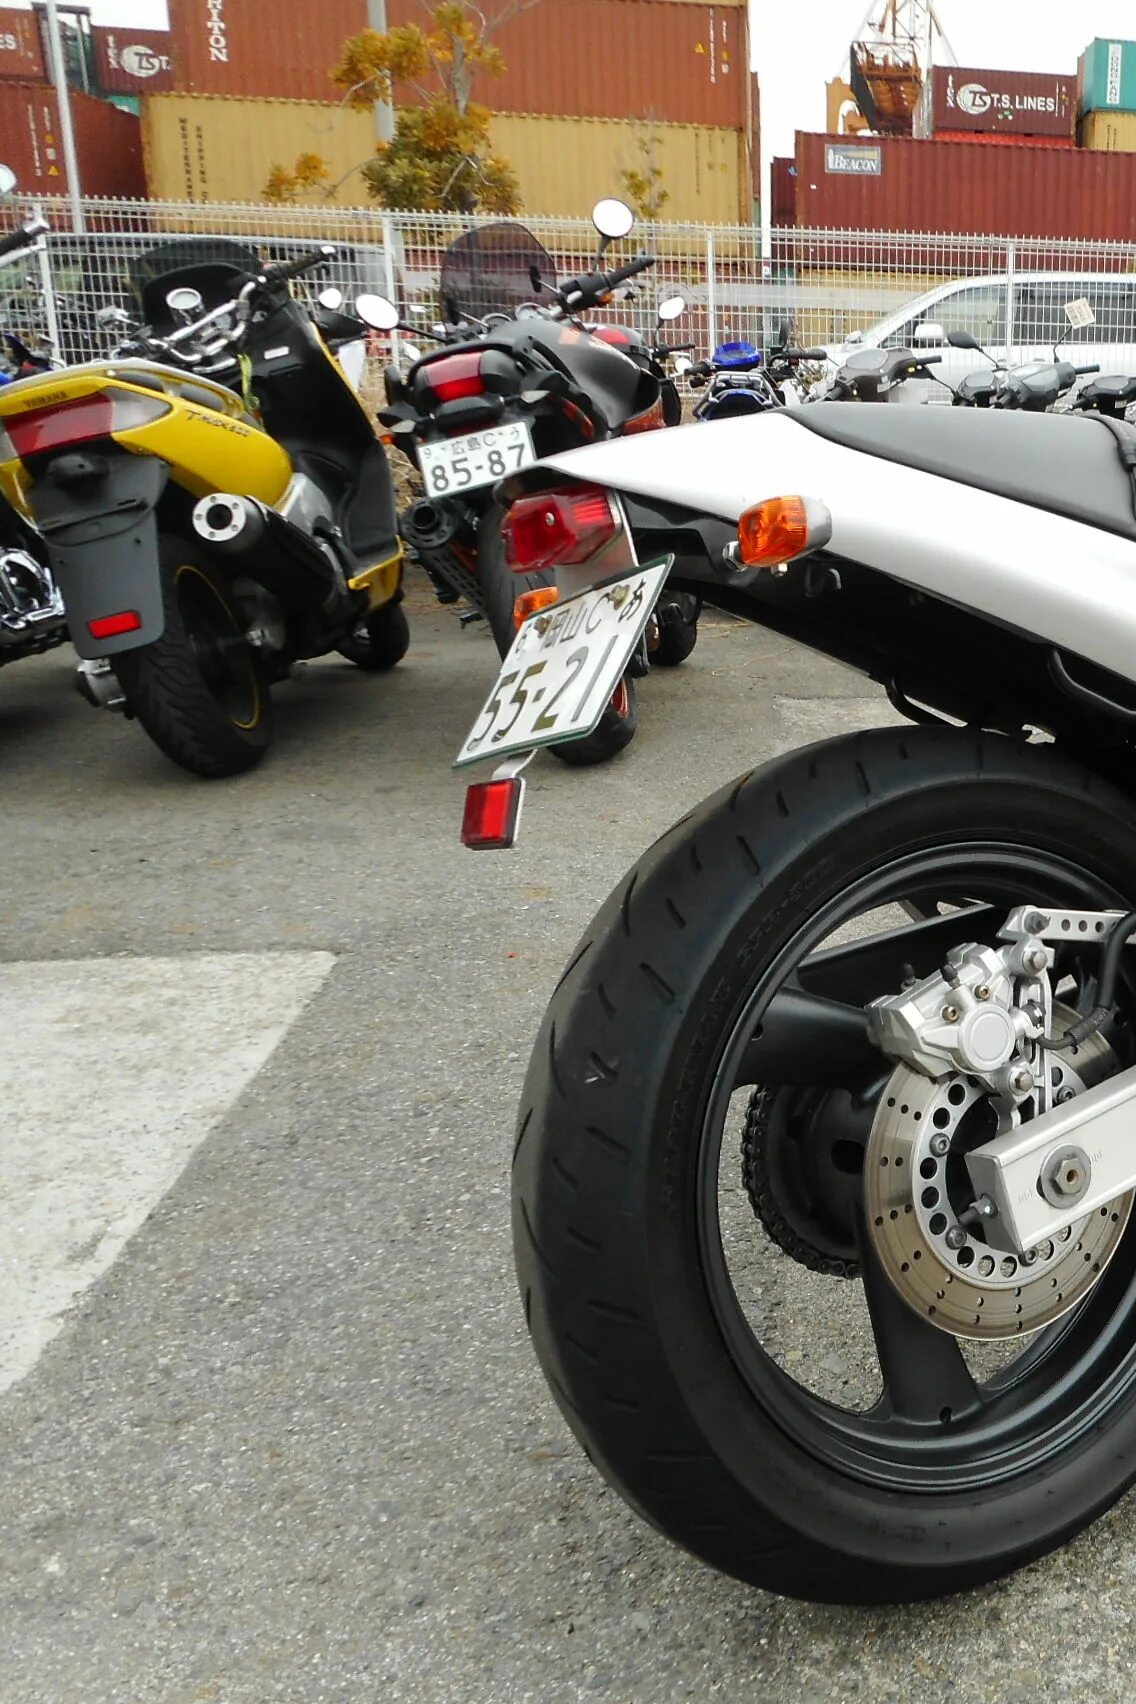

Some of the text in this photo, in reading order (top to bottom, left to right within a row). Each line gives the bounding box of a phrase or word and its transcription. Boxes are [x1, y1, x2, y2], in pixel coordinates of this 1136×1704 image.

[206, 0, 229, 61] RITON
[991, 93, 1014, 110] T.S.
[1015, 95, 1055, 112] LINES
[431, 442, 525, 492] 85-87
[467, 634, 619, 752] 55-21
